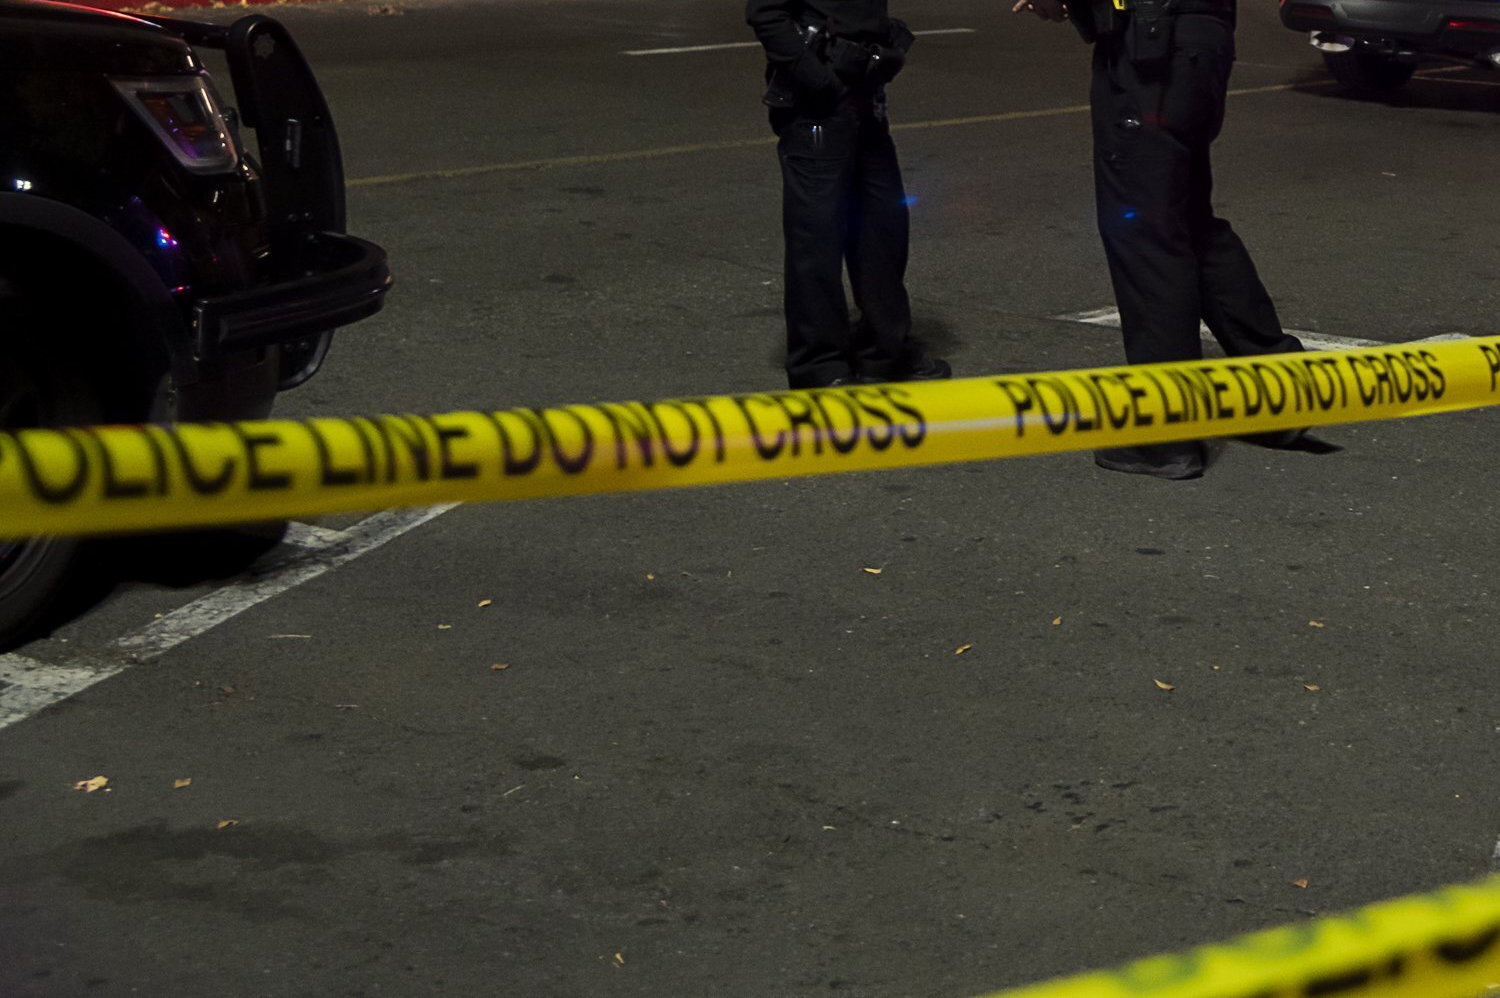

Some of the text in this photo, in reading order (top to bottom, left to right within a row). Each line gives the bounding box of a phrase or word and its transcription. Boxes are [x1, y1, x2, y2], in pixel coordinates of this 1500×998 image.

[309, 412, 481, 489] LINE
[491, 404, 600, 477] DO
[605, 398, 733, 470] NOT
[738, 388, 929, 462] CROSS
[997, 350, 1448, 438] POLICE LINE DO NOT CROSS
